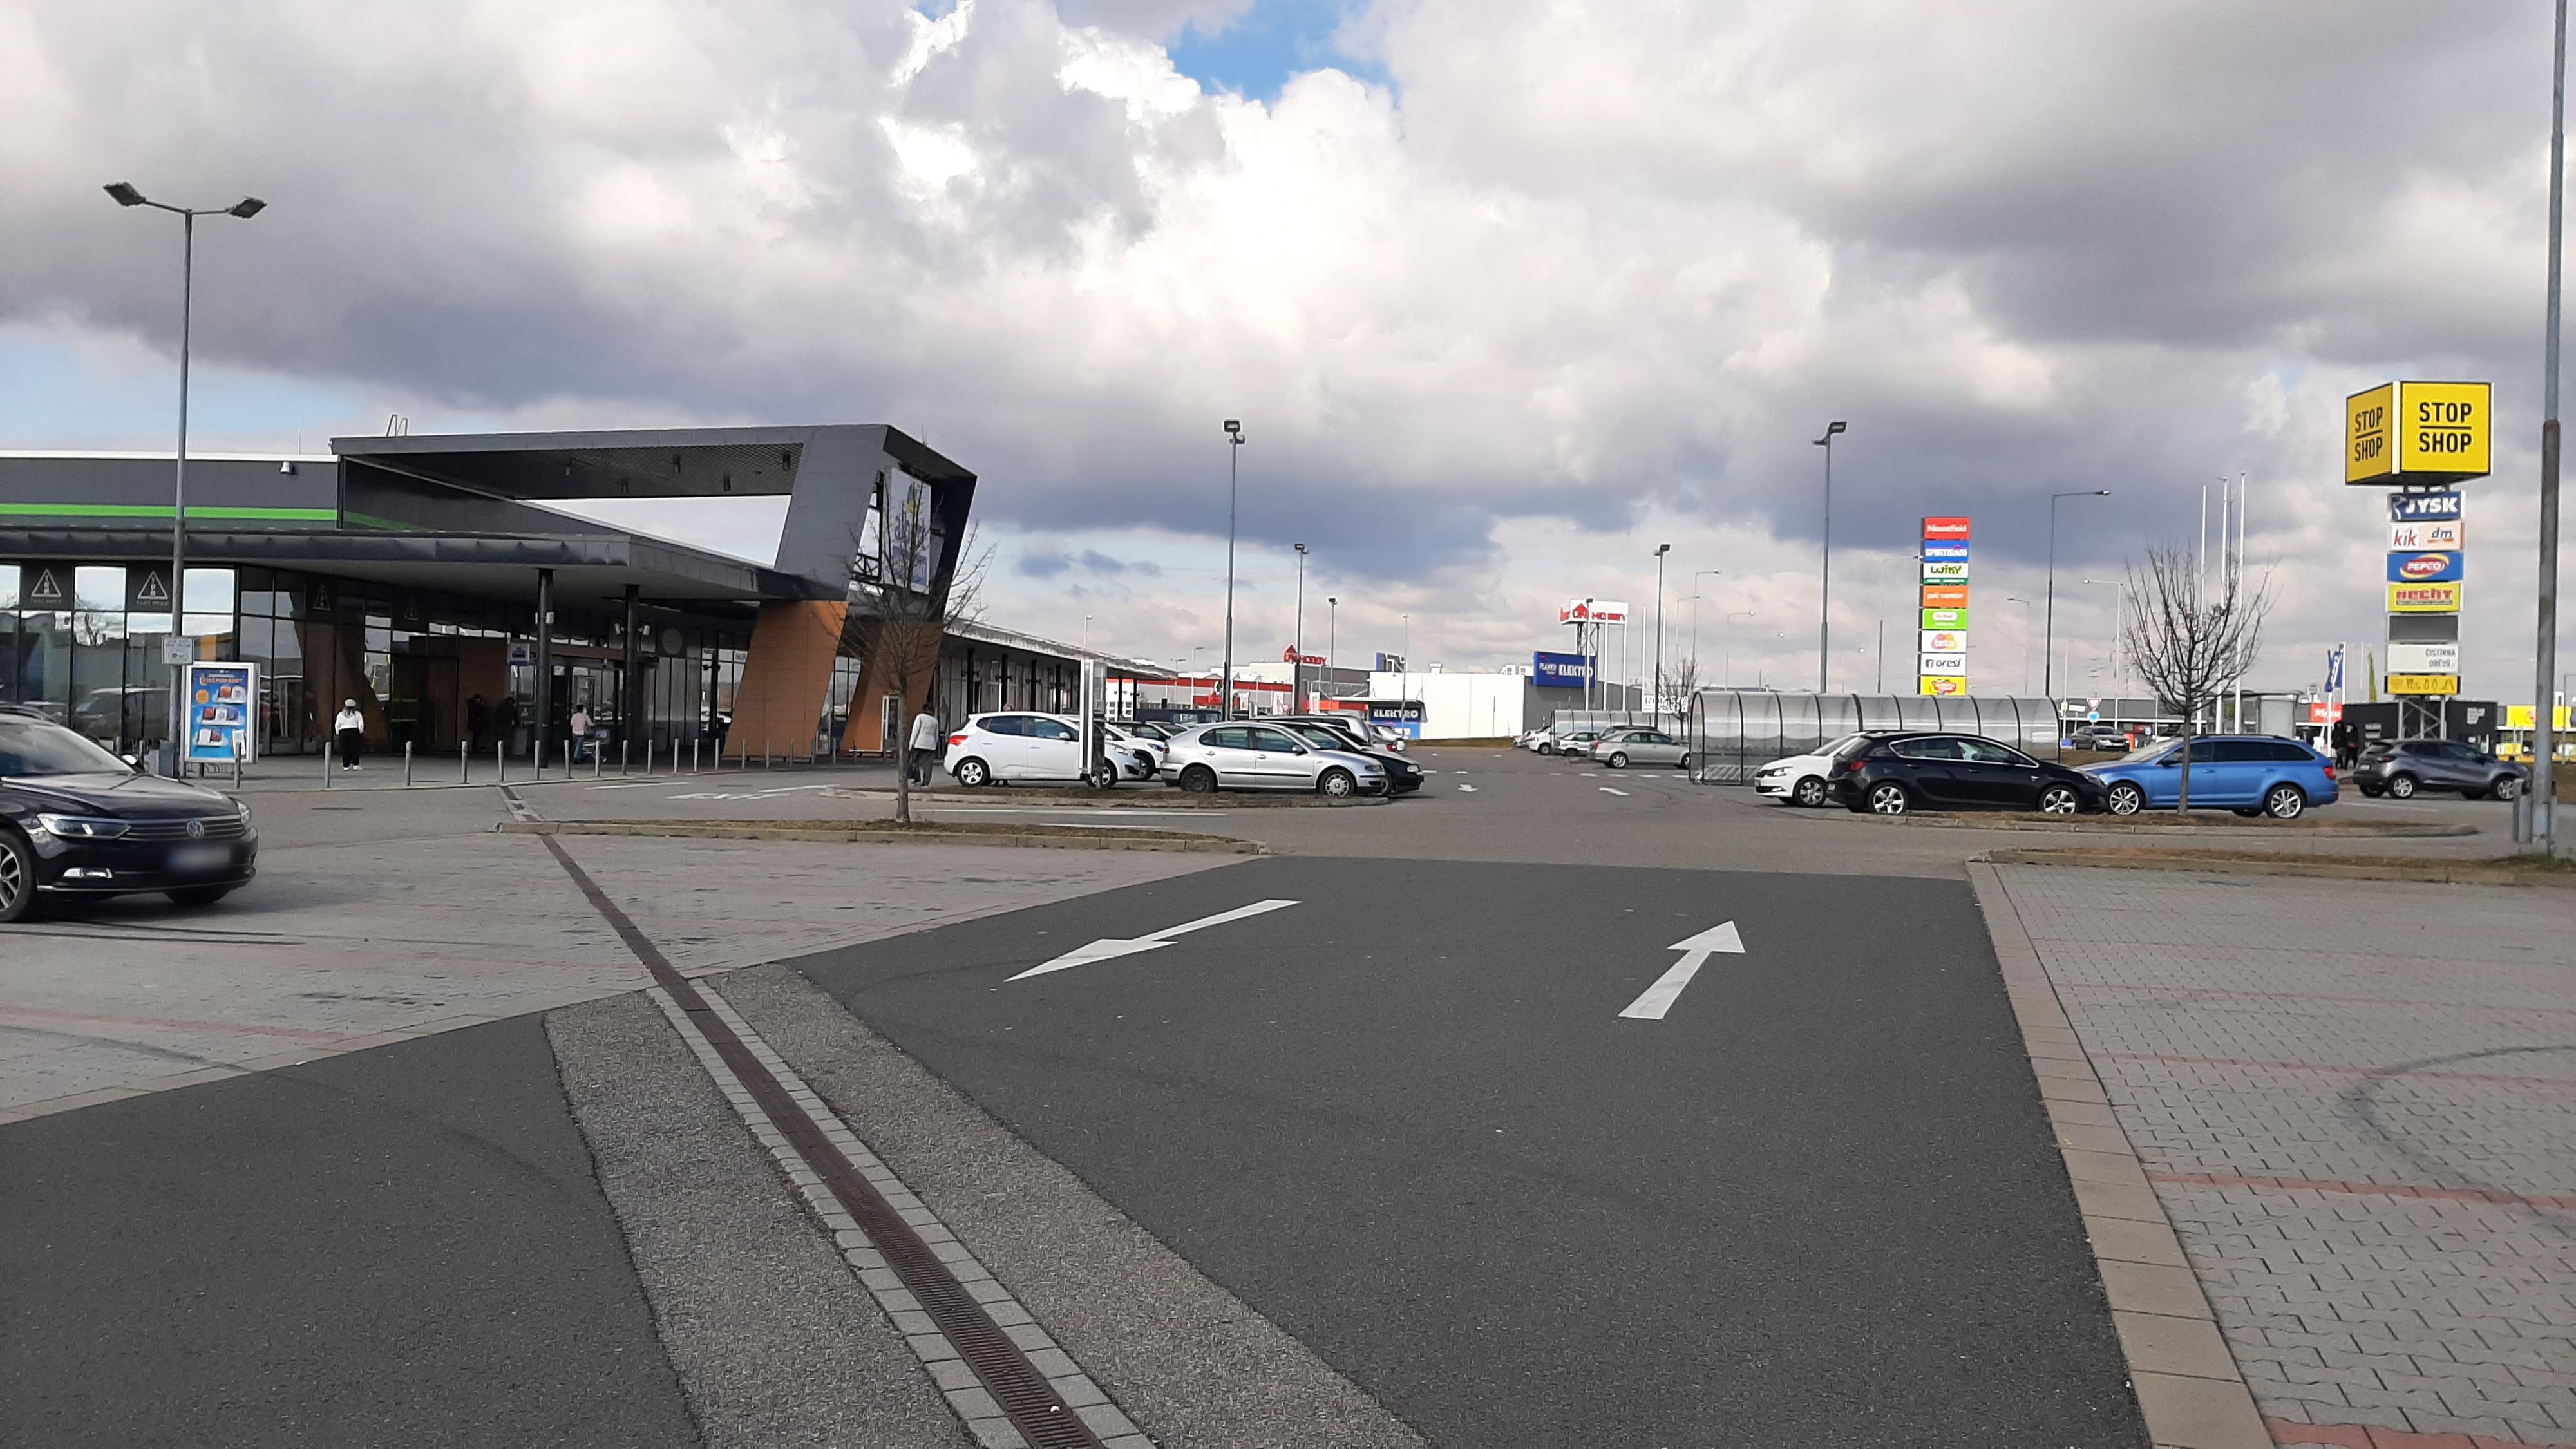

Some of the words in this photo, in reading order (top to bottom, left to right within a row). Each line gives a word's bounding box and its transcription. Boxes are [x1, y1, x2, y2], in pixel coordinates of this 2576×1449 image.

[2354, 406, 2383, 433] STOP
[2419, 402, 2472, 422] STOP
[2354, 437, 2383, 462] SHOP
[2419, 432, 2472, 453] SHOP
[2405, 497, 2458, 513] JYSK
[2431, 527, 2452, 538] dm
